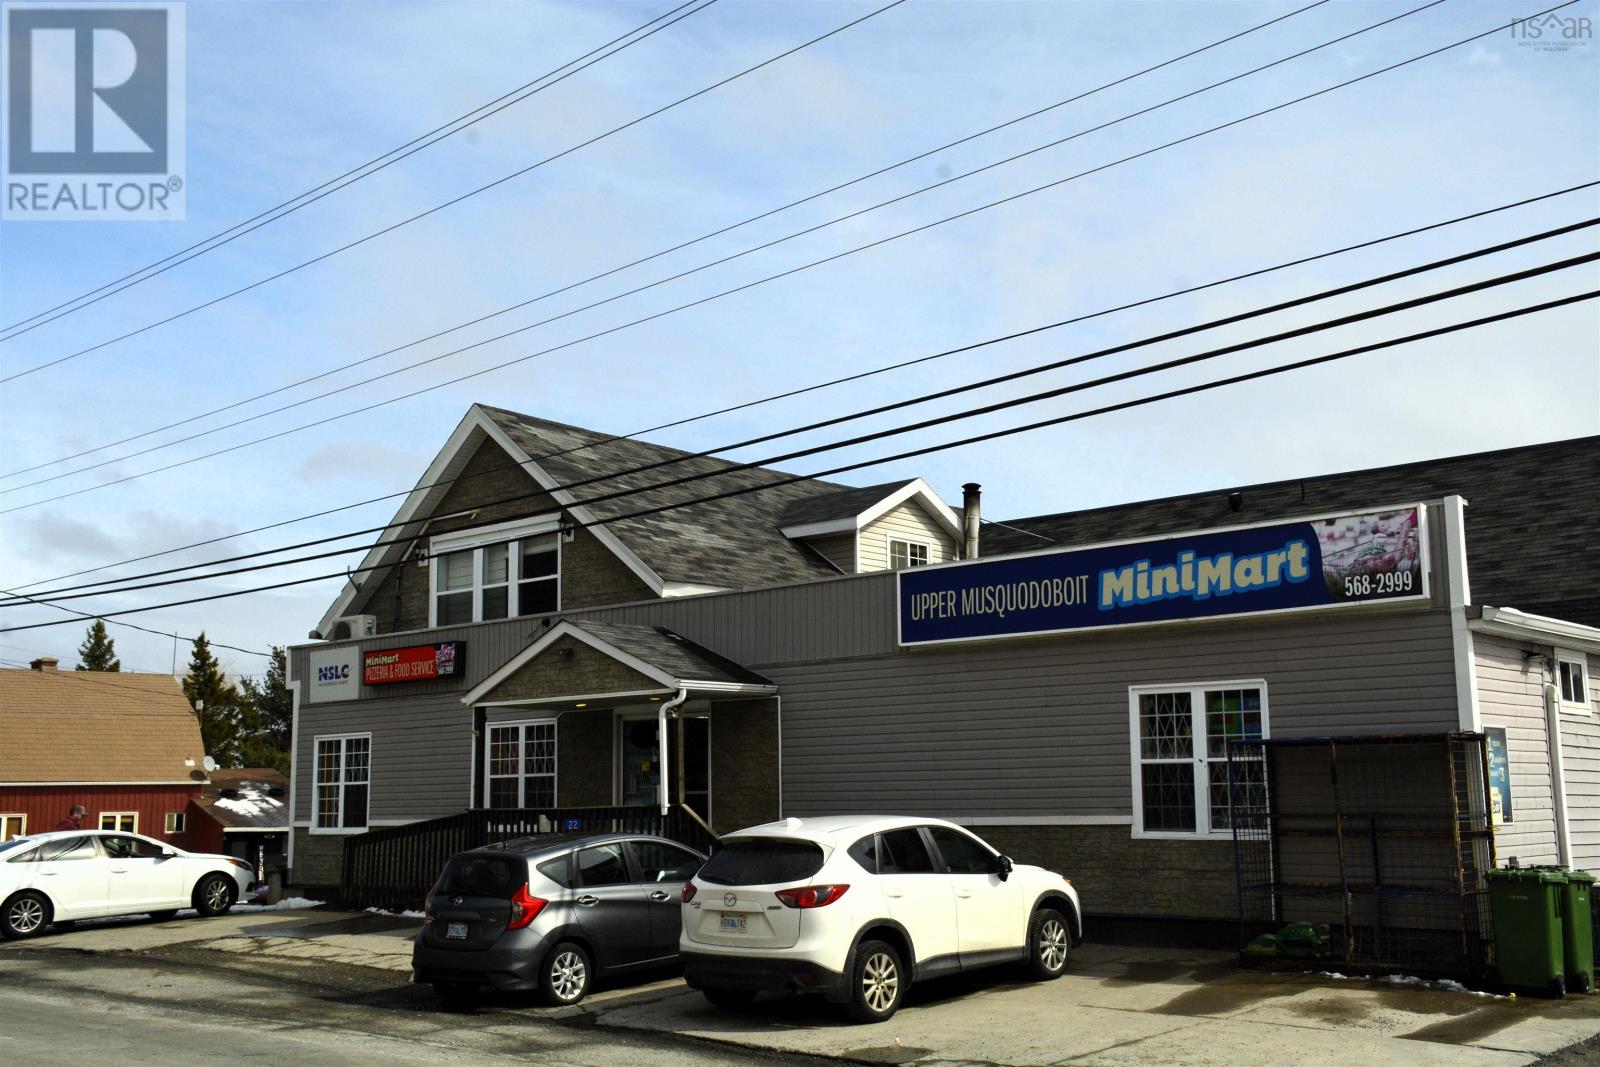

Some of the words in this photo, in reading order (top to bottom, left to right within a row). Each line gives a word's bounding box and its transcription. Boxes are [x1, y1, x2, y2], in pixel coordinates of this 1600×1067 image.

[1098, 539, 1309, 612] MiniMart
[1344, 570, 1414, 598] 568-2999
[911, 588, 957, 621] UPPER
[961, 574, 1090, 620] MUSQUODOBOIT
[365, 653, 399, 668] MiniMart
[366, 665, 389, 682] PIZZERIA
[395, 662, 411, 678] FOOD
[411, 659, 435, 676] SERVICE
[318, 664, 350, 682] NSLC
[568, 820, 579, 830] 22
